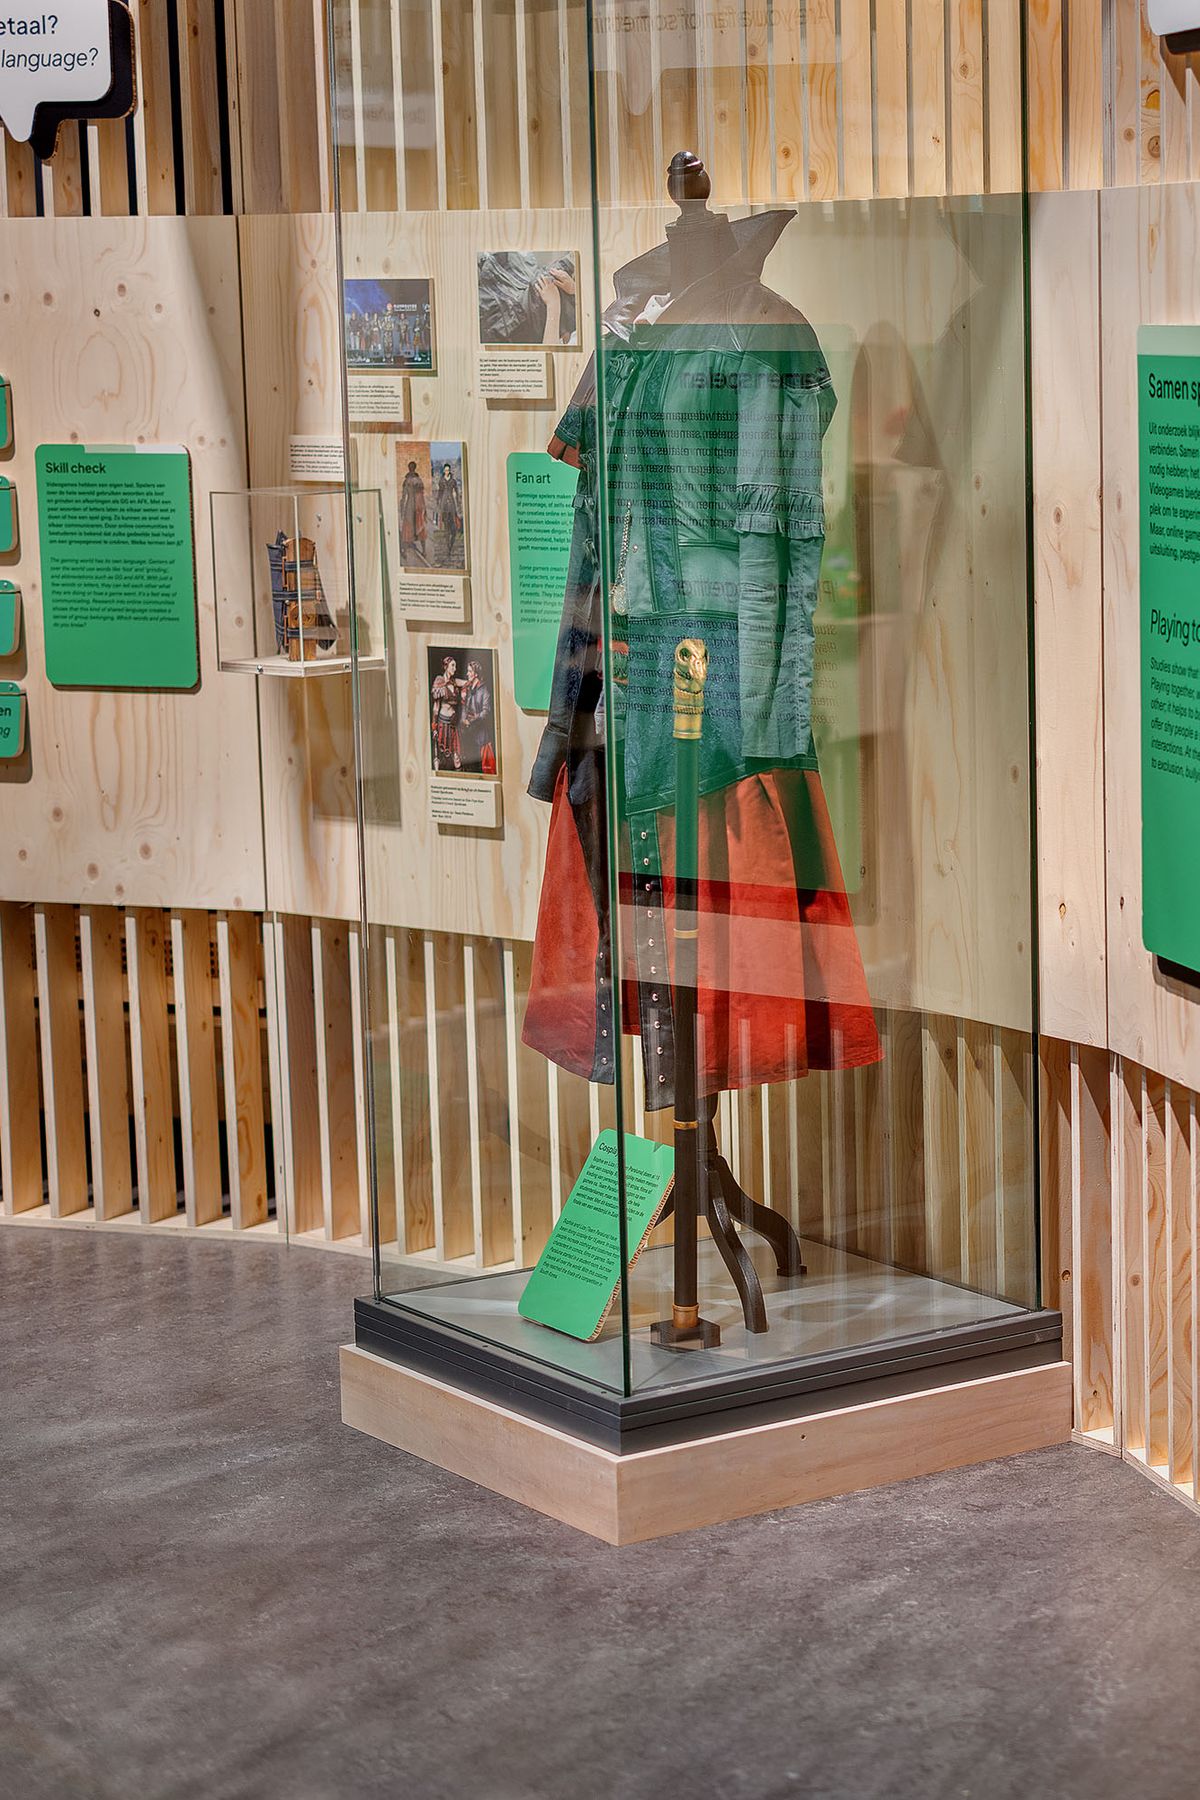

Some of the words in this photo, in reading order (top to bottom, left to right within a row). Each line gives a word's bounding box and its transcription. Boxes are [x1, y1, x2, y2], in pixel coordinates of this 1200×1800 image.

[1, 47, 99, 72] language?
[1149, 373, 1188, 399] Samen
[45, 462, 69, 474] Skill
[71, 462, 106, 474] check
[516, 471, 533, 483] Fan
[536, 474, 550, 483] art
[1150, 609, 1189, 646] Playing
